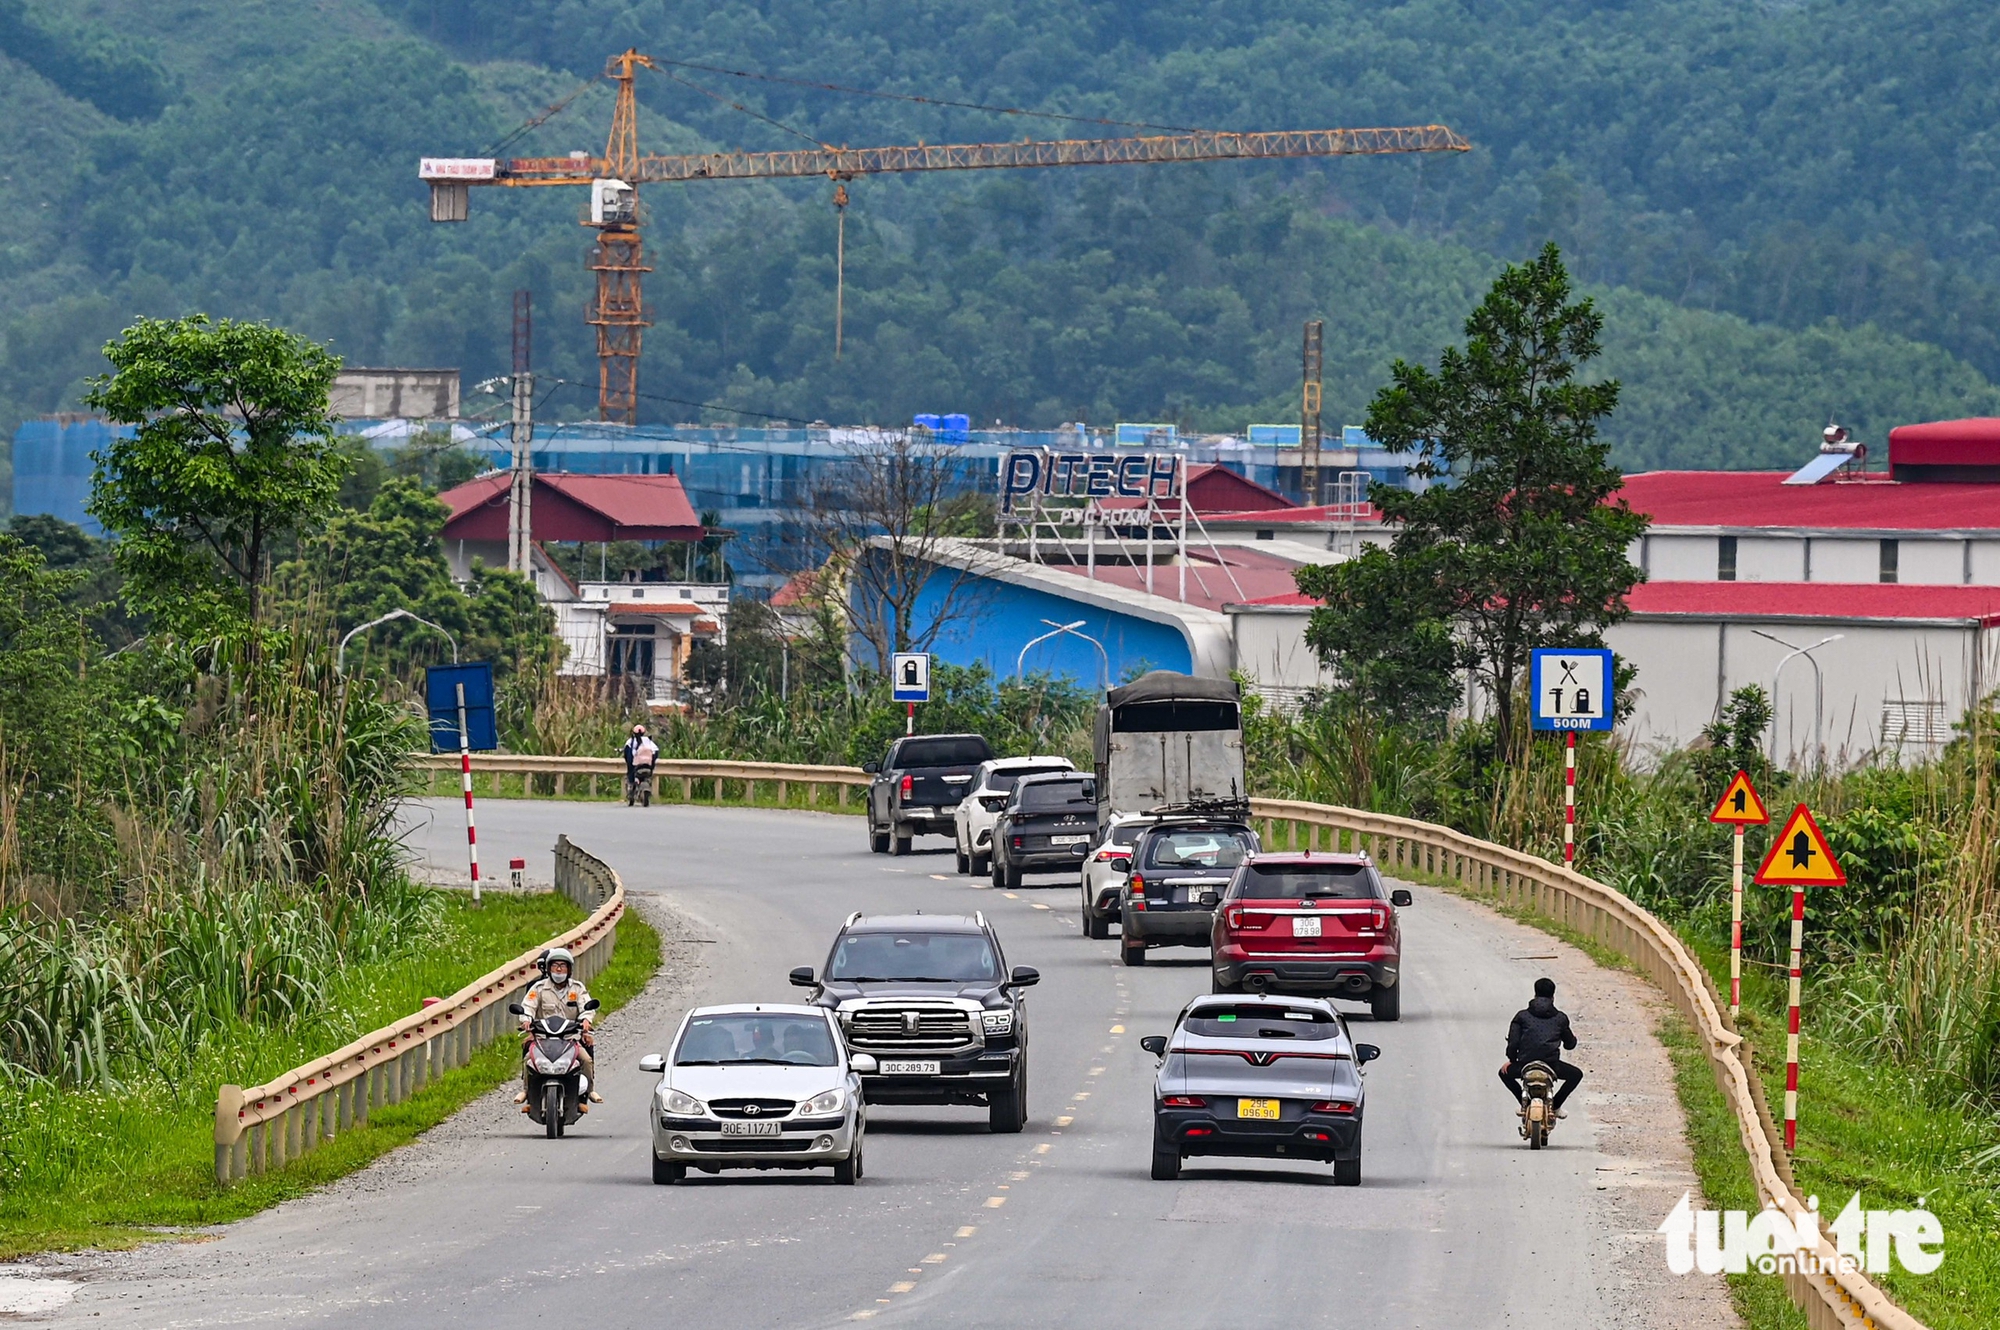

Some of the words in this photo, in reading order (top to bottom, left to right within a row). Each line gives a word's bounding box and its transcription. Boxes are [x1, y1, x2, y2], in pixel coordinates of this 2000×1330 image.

[1001, 450, 1178, 515] PITECH
[1100, 508, 1152, 526] FOAM
[1554, 718, 1591, 729] 500M
[1299, 918, 1315, 927] 30G
[1249, 1098, 1268, 1109] 29E
[1242, 1108, 1275, 1118] 096.90
[722, 1122, 779, 1135] 30E-117.71
